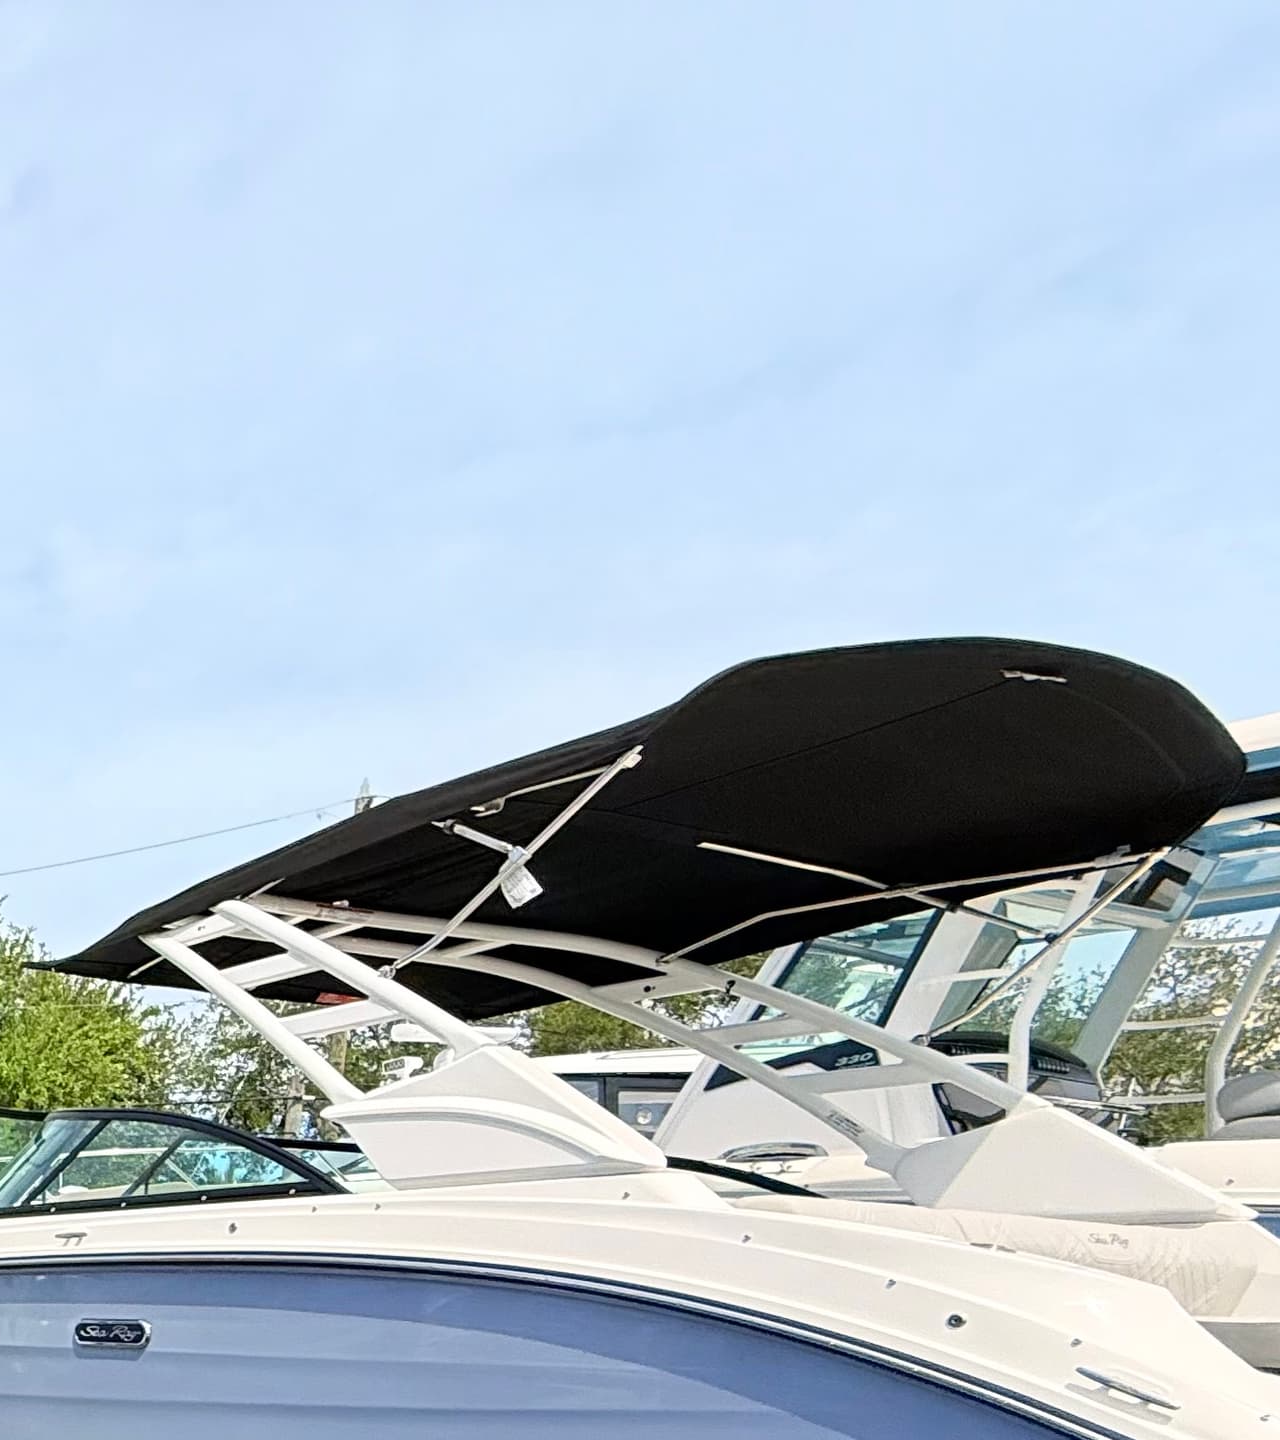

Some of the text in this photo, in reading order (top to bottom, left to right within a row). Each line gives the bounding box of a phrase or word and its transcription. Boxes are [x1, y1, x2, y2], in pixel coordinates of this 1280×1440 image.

[835, 1052, 873, 1066] 330
[80, 1325, 142, 1342] Sea Ray
